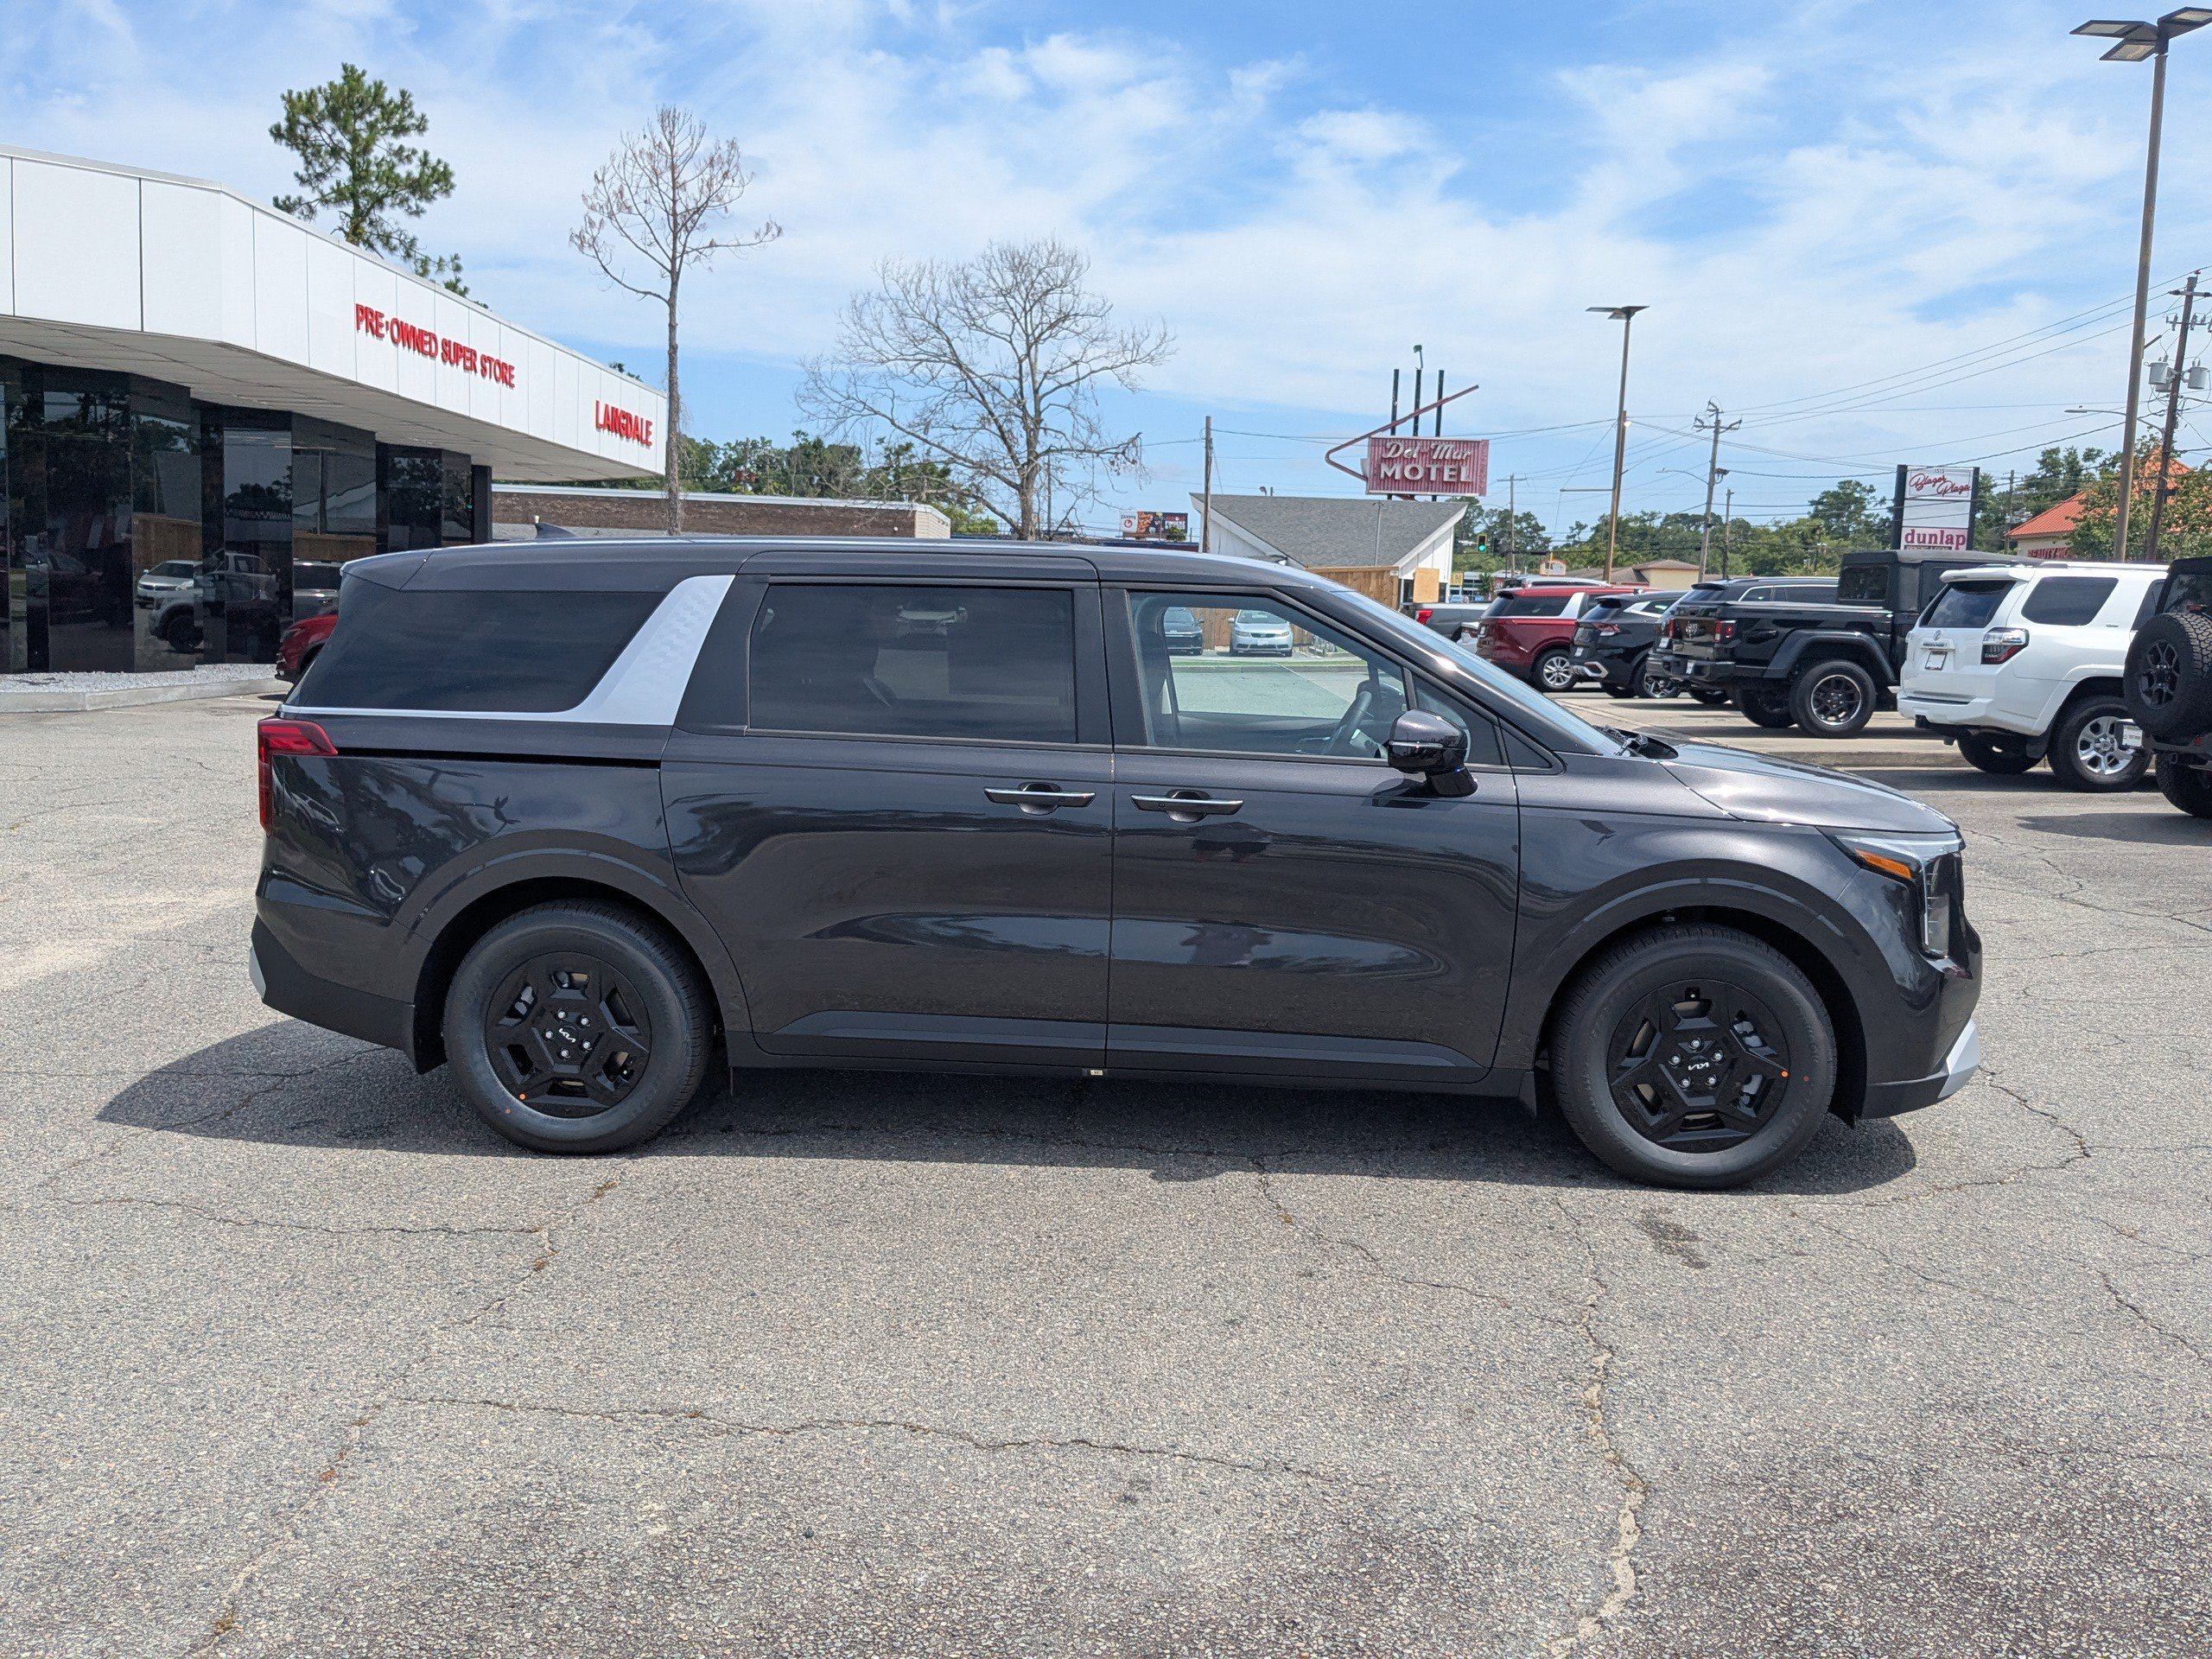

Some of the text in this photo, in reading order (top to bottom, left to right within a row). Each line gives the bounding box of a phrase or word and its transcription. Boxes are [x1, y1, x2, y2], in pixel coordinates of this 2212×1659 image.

[441, 338, 478, 373] SUPER
[480, 354, 516, 389] STORE
[594, 399, 653, 447] LANGDALE
[1382, 441, 1471, 461] Del Mar
[1380, 462, 1472, 483] MOTEL
[1904, 528, 1967, 550] dunlap
